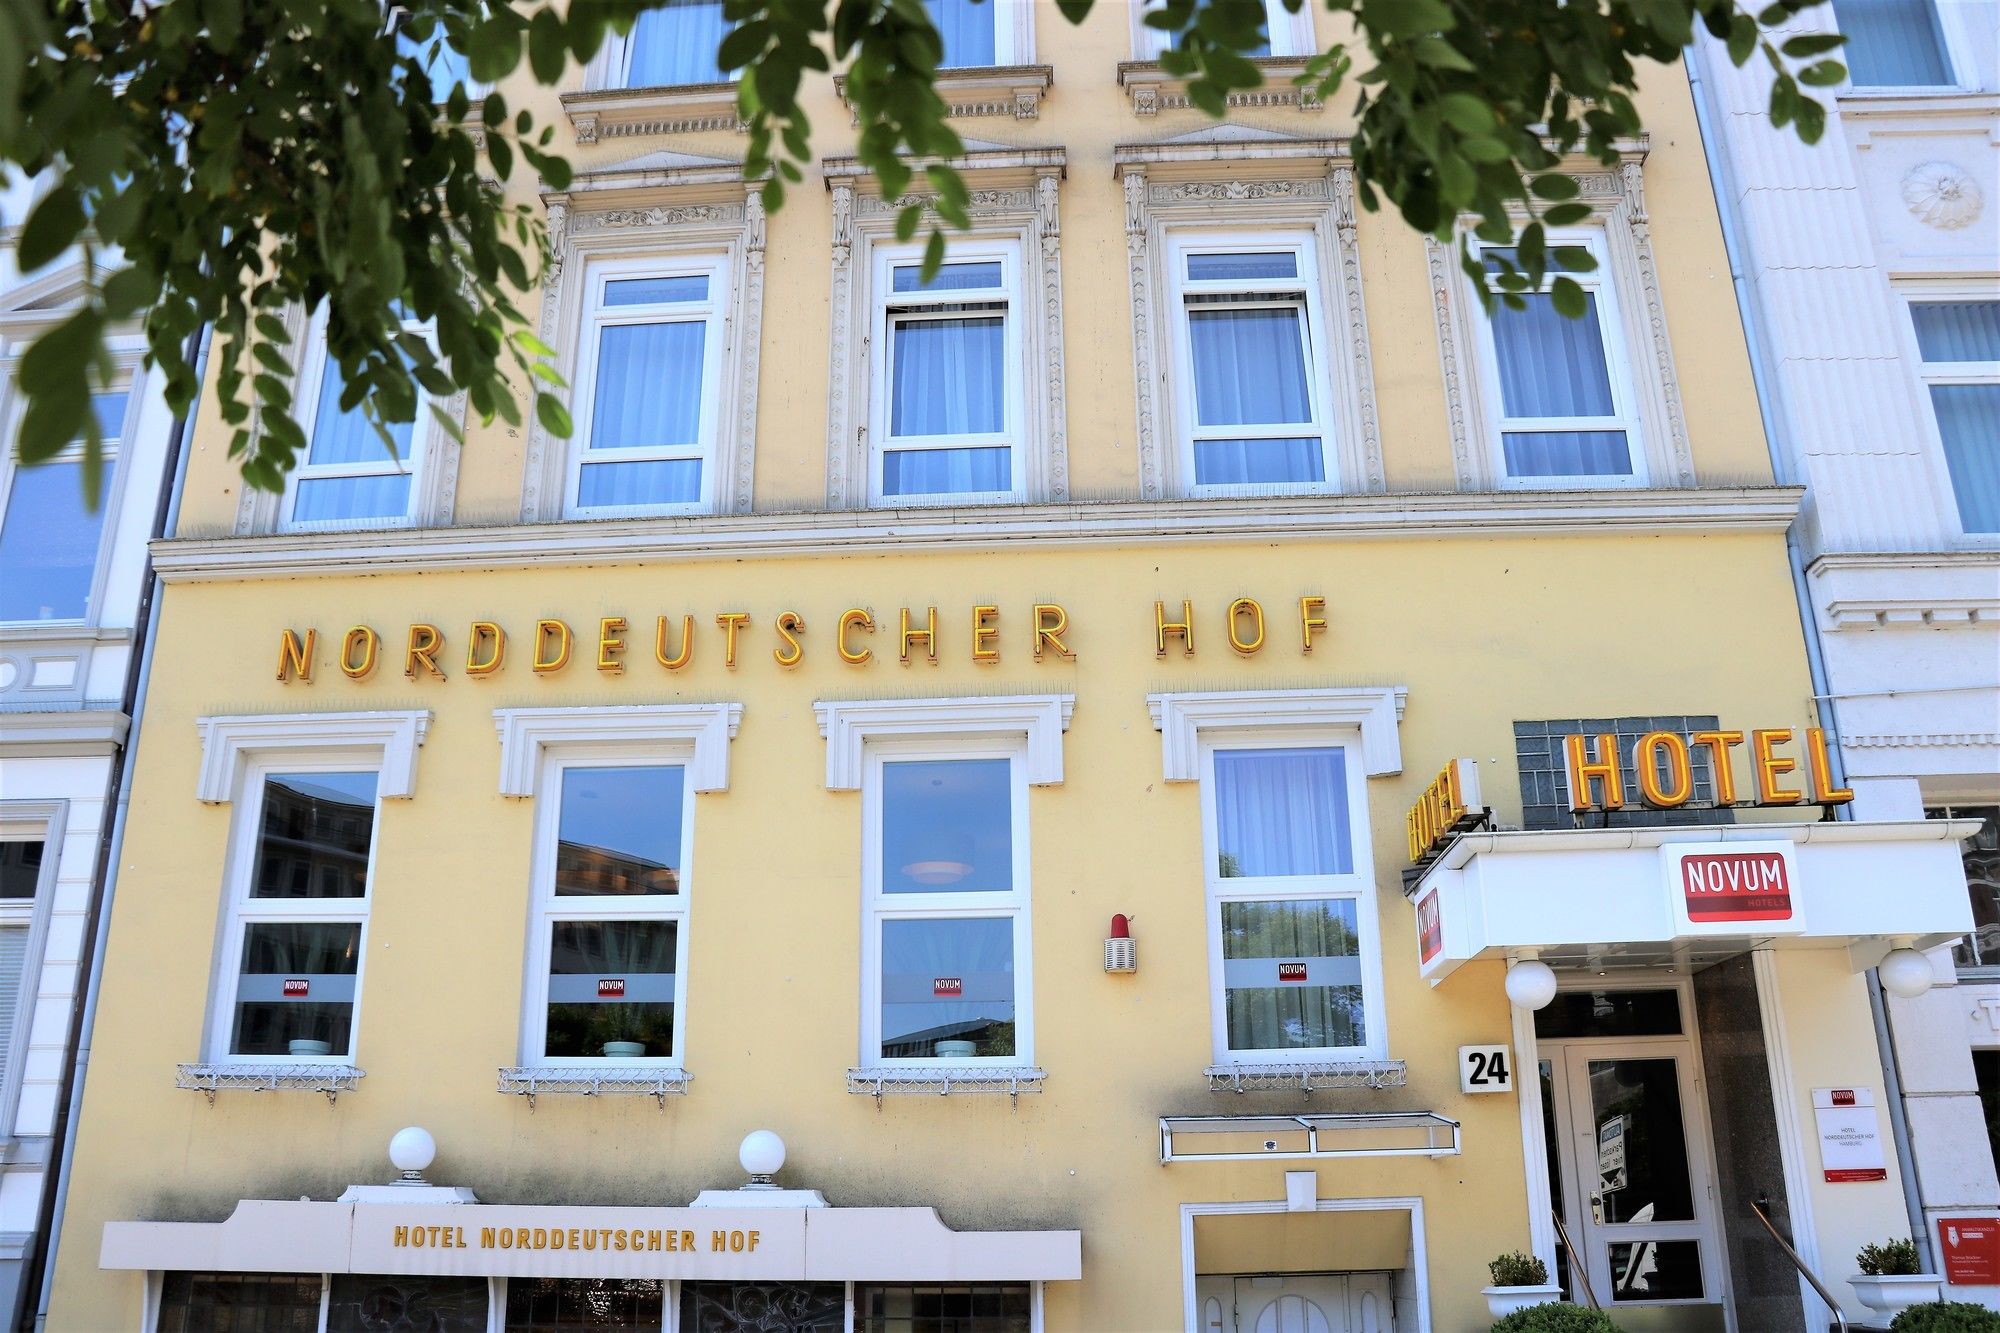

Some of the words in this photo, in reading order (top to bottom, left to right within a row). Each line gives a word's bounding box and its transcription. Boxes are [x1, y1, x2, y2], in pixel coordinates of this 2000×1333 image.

[276, 602, 1077, 684] NORDDEUTSCHER
[1155, 596, 1327, 660] HOF
[1563, 727, 1854, 813] HOTEL
[1407, 758, 1468, 864] HOTEL
[1687, 859, 1783, 893] NOVUM
[1418, 894, 1439, 938] NOVUM
[1747, 898, 1786, 908] HOTELS
[1280, 964, 1306, 974] NOVUM
[285, 980, 309, 990] NOVUM
[599, 980, 624, 990] NOVUM
[935, 979, 961, 989] NOVUM
[1468, 1052, 1509, 1084] 24
[1832, 1090, 1854, 1099] NOVUM
[394, 1225, 467, 1249] HOTEL
[480, 1226, 697, 1252] NORDDEUTSCHER
[711, 1229, 761, 1252] HOF
